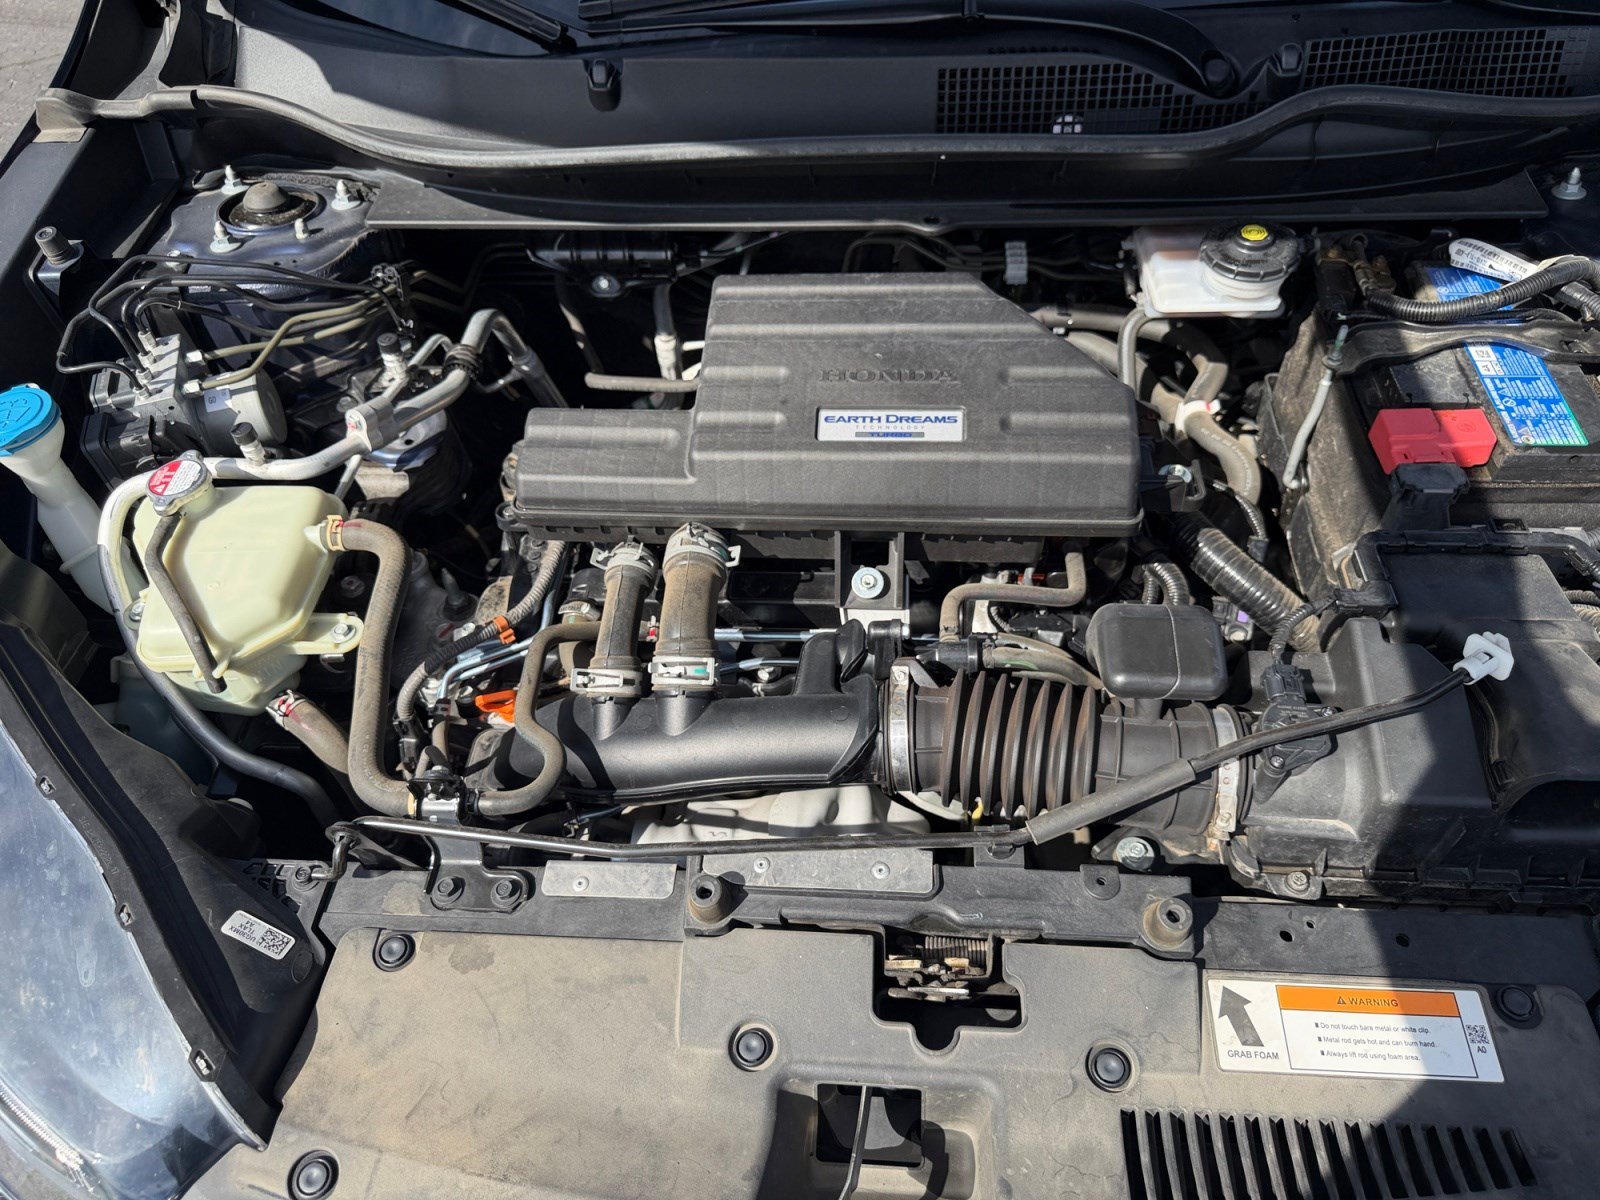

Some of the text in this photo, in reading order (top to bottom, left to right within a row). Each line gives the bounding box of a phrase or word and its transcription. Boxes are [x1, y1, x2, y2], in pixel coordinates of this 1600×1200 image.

[820, 369, 961, 383] HONDA
[824, 414, 958, 424] EARTH DREAMS
[1348, 996, 1399, 1008] WARNING
[1341, 1023, 1359, 1031] touch
[1418, 1026, 1431, 1034] clip.
[1419, 1040, 1438, 1048] hand.
[1227, 1049, 1279, 1060] GRAB FOAM
[1326, 1050, 1348, 1059] Always
[1369, 1053, 1386, 1061] using
